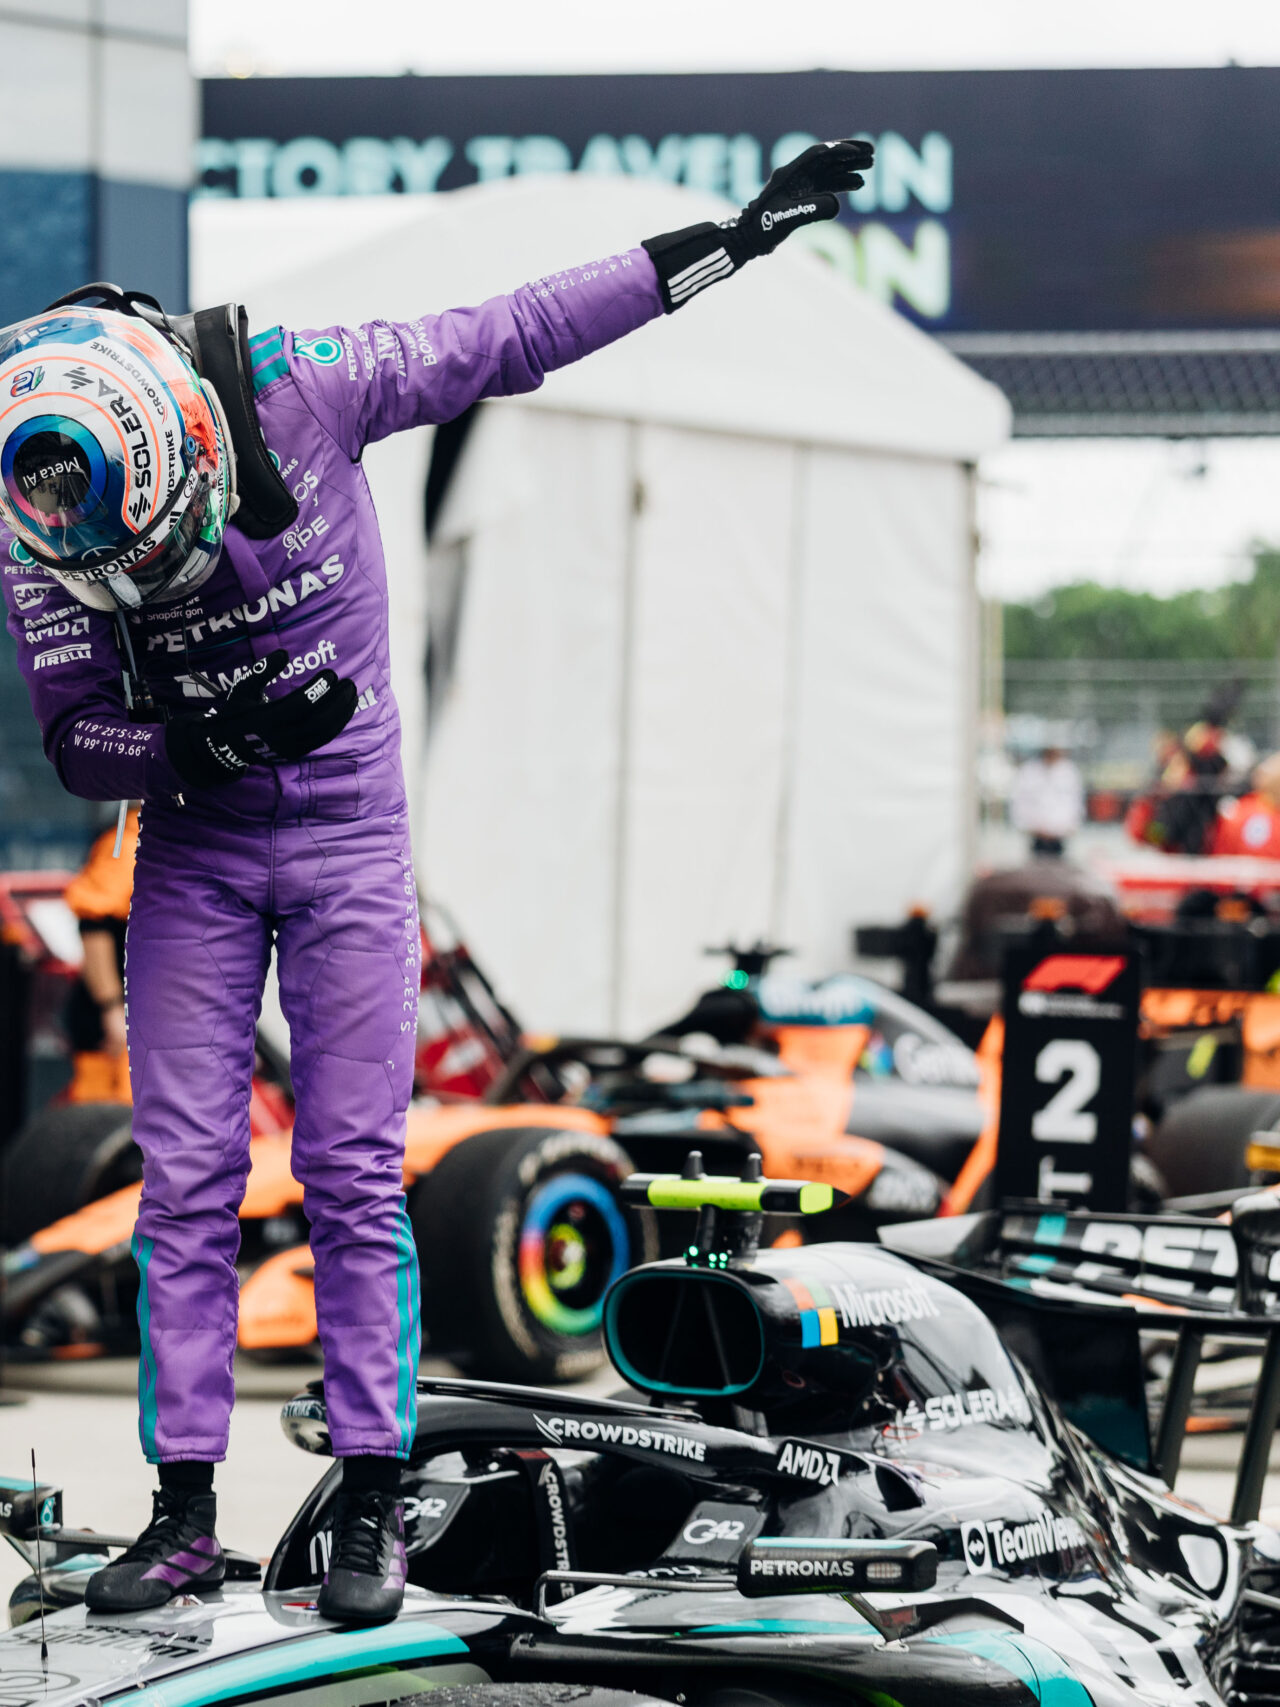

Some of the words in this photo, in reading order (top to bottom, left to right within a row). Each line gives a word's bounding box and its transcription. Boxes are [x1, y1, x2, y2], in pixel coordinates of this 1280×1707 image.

[198, 135, 453, 200] CTORY
[772, 203, 817, 223] WhatsApp
[90, 341, 165, 416] CROWDSTRIKE
[98, 377, 152, 489] SOLERA
[22, 474, 38, 489] AI
[40, 456, 81, 480] Meta
[60, 536, 157, 582] PETRONAS
[25, 620, 71, 645] AMD
[33, 643, 92, 671] PIRELLI
[306, 678, 330, 701] OMP
[1032, 1038, 1101, 1144] 2
[831, 1277, 940, 1328] Microsoft
[547, 1416, 707, 1462] CROWDSTRIKE
[777, 1442, 822, 1482] AMD
[683, 1518, 745, 1544] G42
[750, 1559, 855, 1577] PETRONAS
